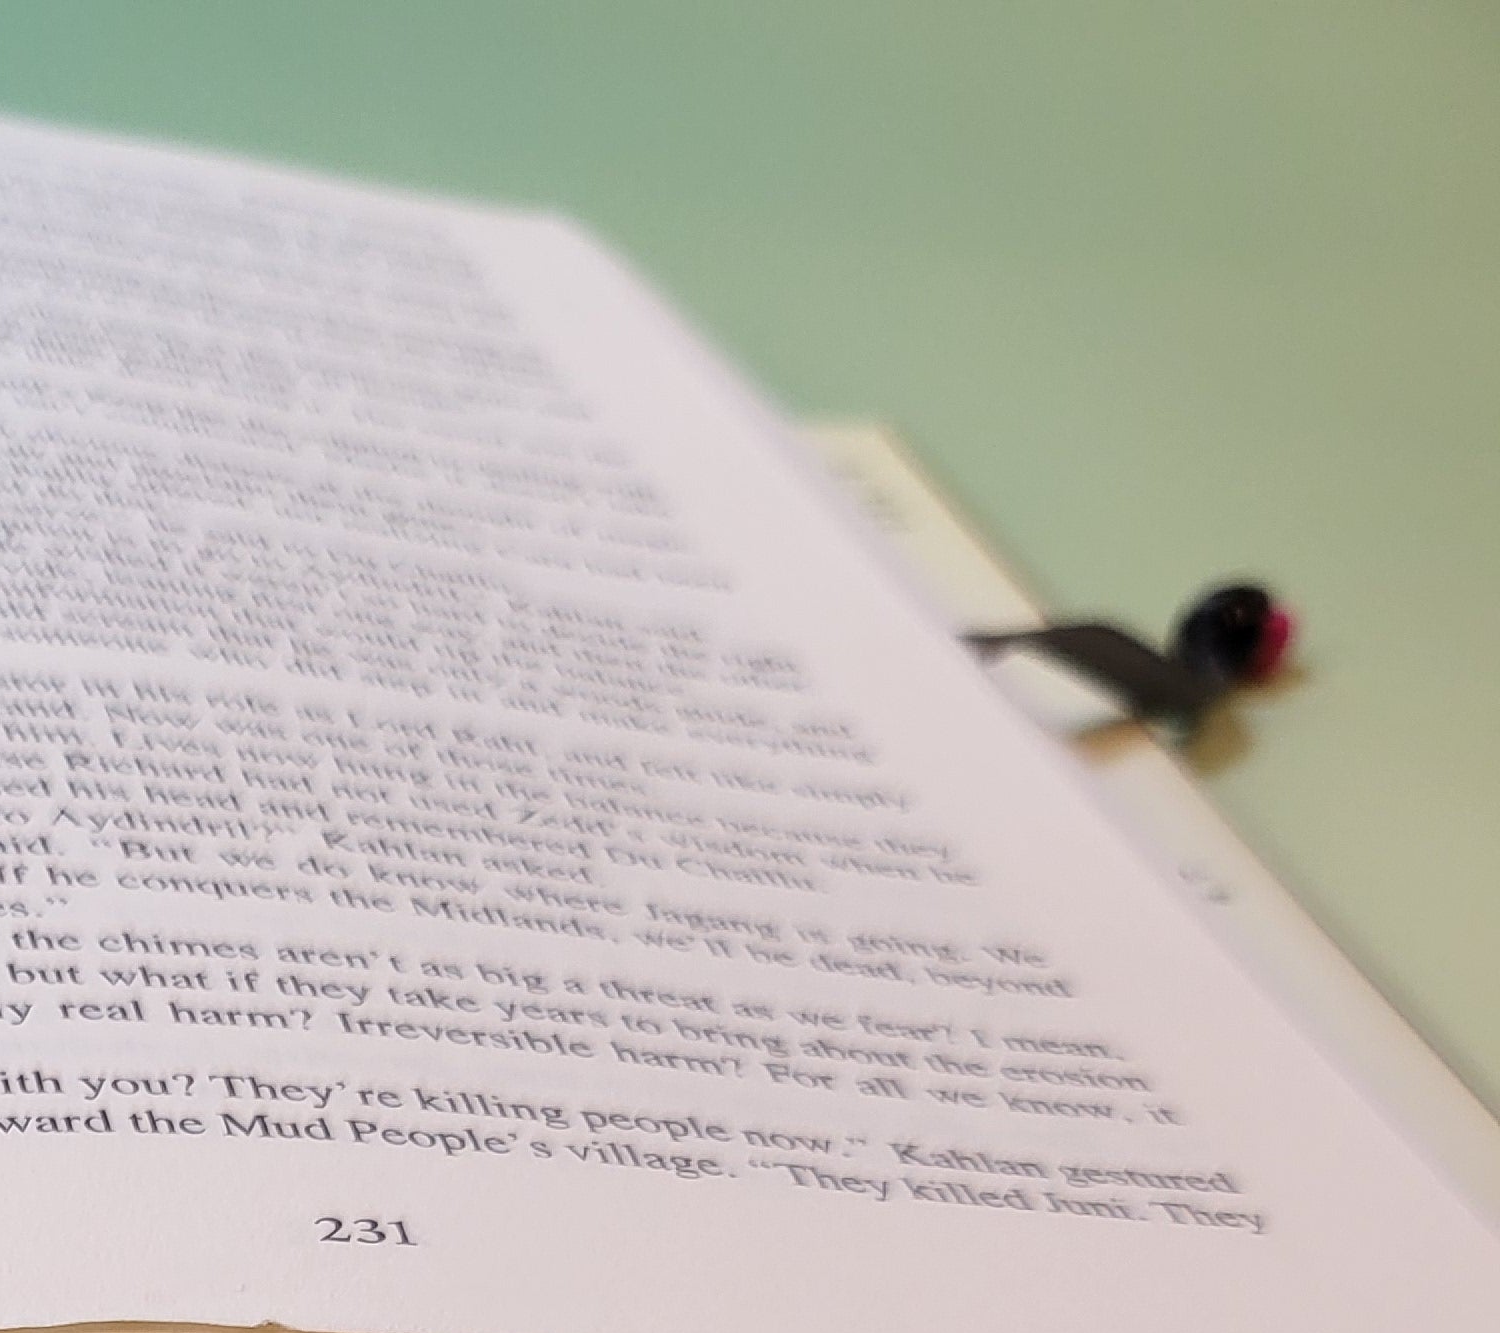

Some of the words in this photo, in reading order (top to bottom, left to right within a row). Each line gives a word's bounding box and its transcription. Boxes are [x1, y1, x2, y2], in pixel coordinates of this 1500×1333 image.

[4, 961, 83, 984] but
[99, 964, 208, 989] what
[225, 969, 261, 993] if
[274, 973, 370, 1007] they
[386, 985, 482, 1013] take
[493, 1000, 606, 1027] years
[620, 1013, 661, 1035] to
[10, 927, 83, 950] the
[97, 930, 261, 960] chimes
[419, 960, 465, 980] as
[475, 961, 550, 994] big
[562, 977, 587, 994] a
[598, 978, 719, 1014] threat
[58, 998, 145, 1021] real
[167, 1000, 314, 1030] harm?
[335, 1009, 595, 1058] Irreversible
[609, 1038, 745, 1077] harm?
[762, 1061, 835, 1090] For
[854, 1075, 910, 1099] all
[925, 1087, 989, 1108] we
[1000, 1090, 1135, 1123] know,
[1146, 1104, 1181, 1125] it
[80, 1073, 196, 1101] you?
[208, 1073, 403, 1109] They're
[413, 1086, 569, 1130] killing
[580, 1109, 732, 1143] people
[888, 1141, 1048, 1179] Kahlan
[1058, 1164, 1239, 1194] gestured
[129, 1108, 207, 1135] the
[221, 1111, 331, 1140] Mud
[347, 1117, 553, 1158] People's
[563, 1139, 738, 1180] village.
[903, 1175, 1033, 1211] killed
[1042, 1190, 1145, 1221] Juni.
[1147, 1199, 1266, 1235] They
[313, 1215, 419, 1247] 231
